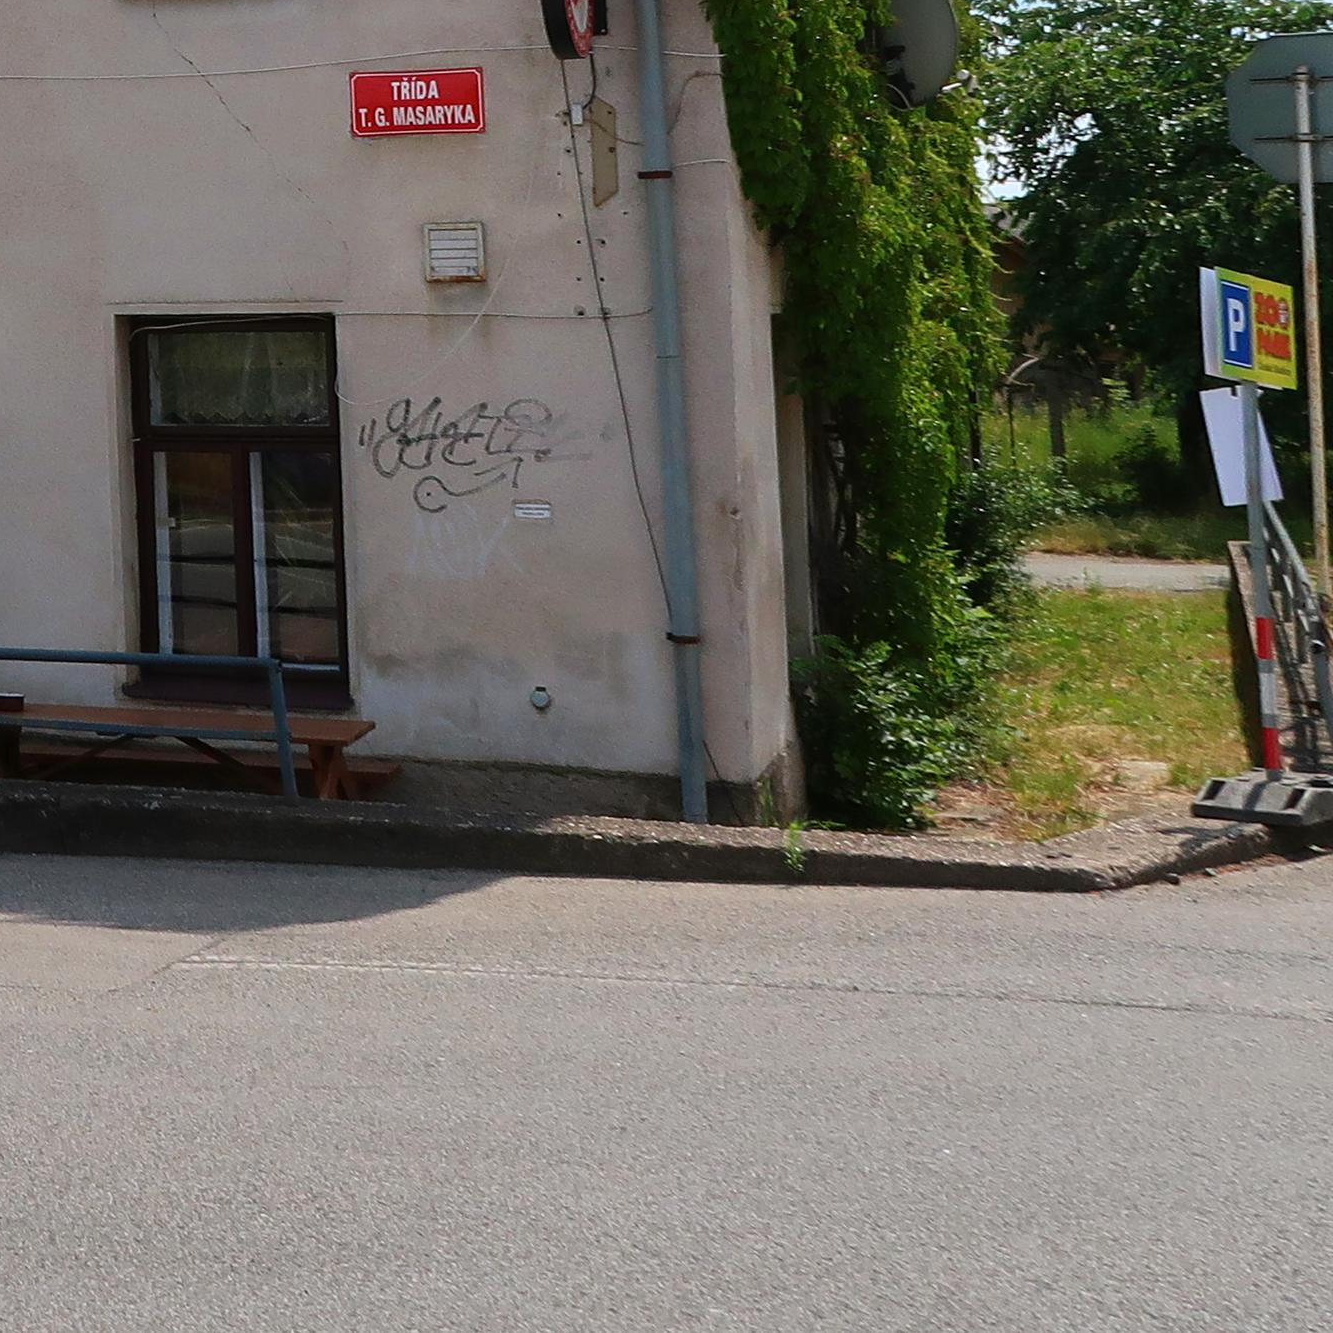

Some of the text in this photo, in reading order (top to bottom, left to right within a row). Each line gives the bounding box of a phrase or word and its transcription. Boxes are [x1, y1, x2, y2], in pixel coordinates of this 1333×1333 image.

[391, 76, 440, 101] TŘÍDA
[358, 104, 476, 127] T. G. MASARYKA
[1226, 297, 1246, 352] P
